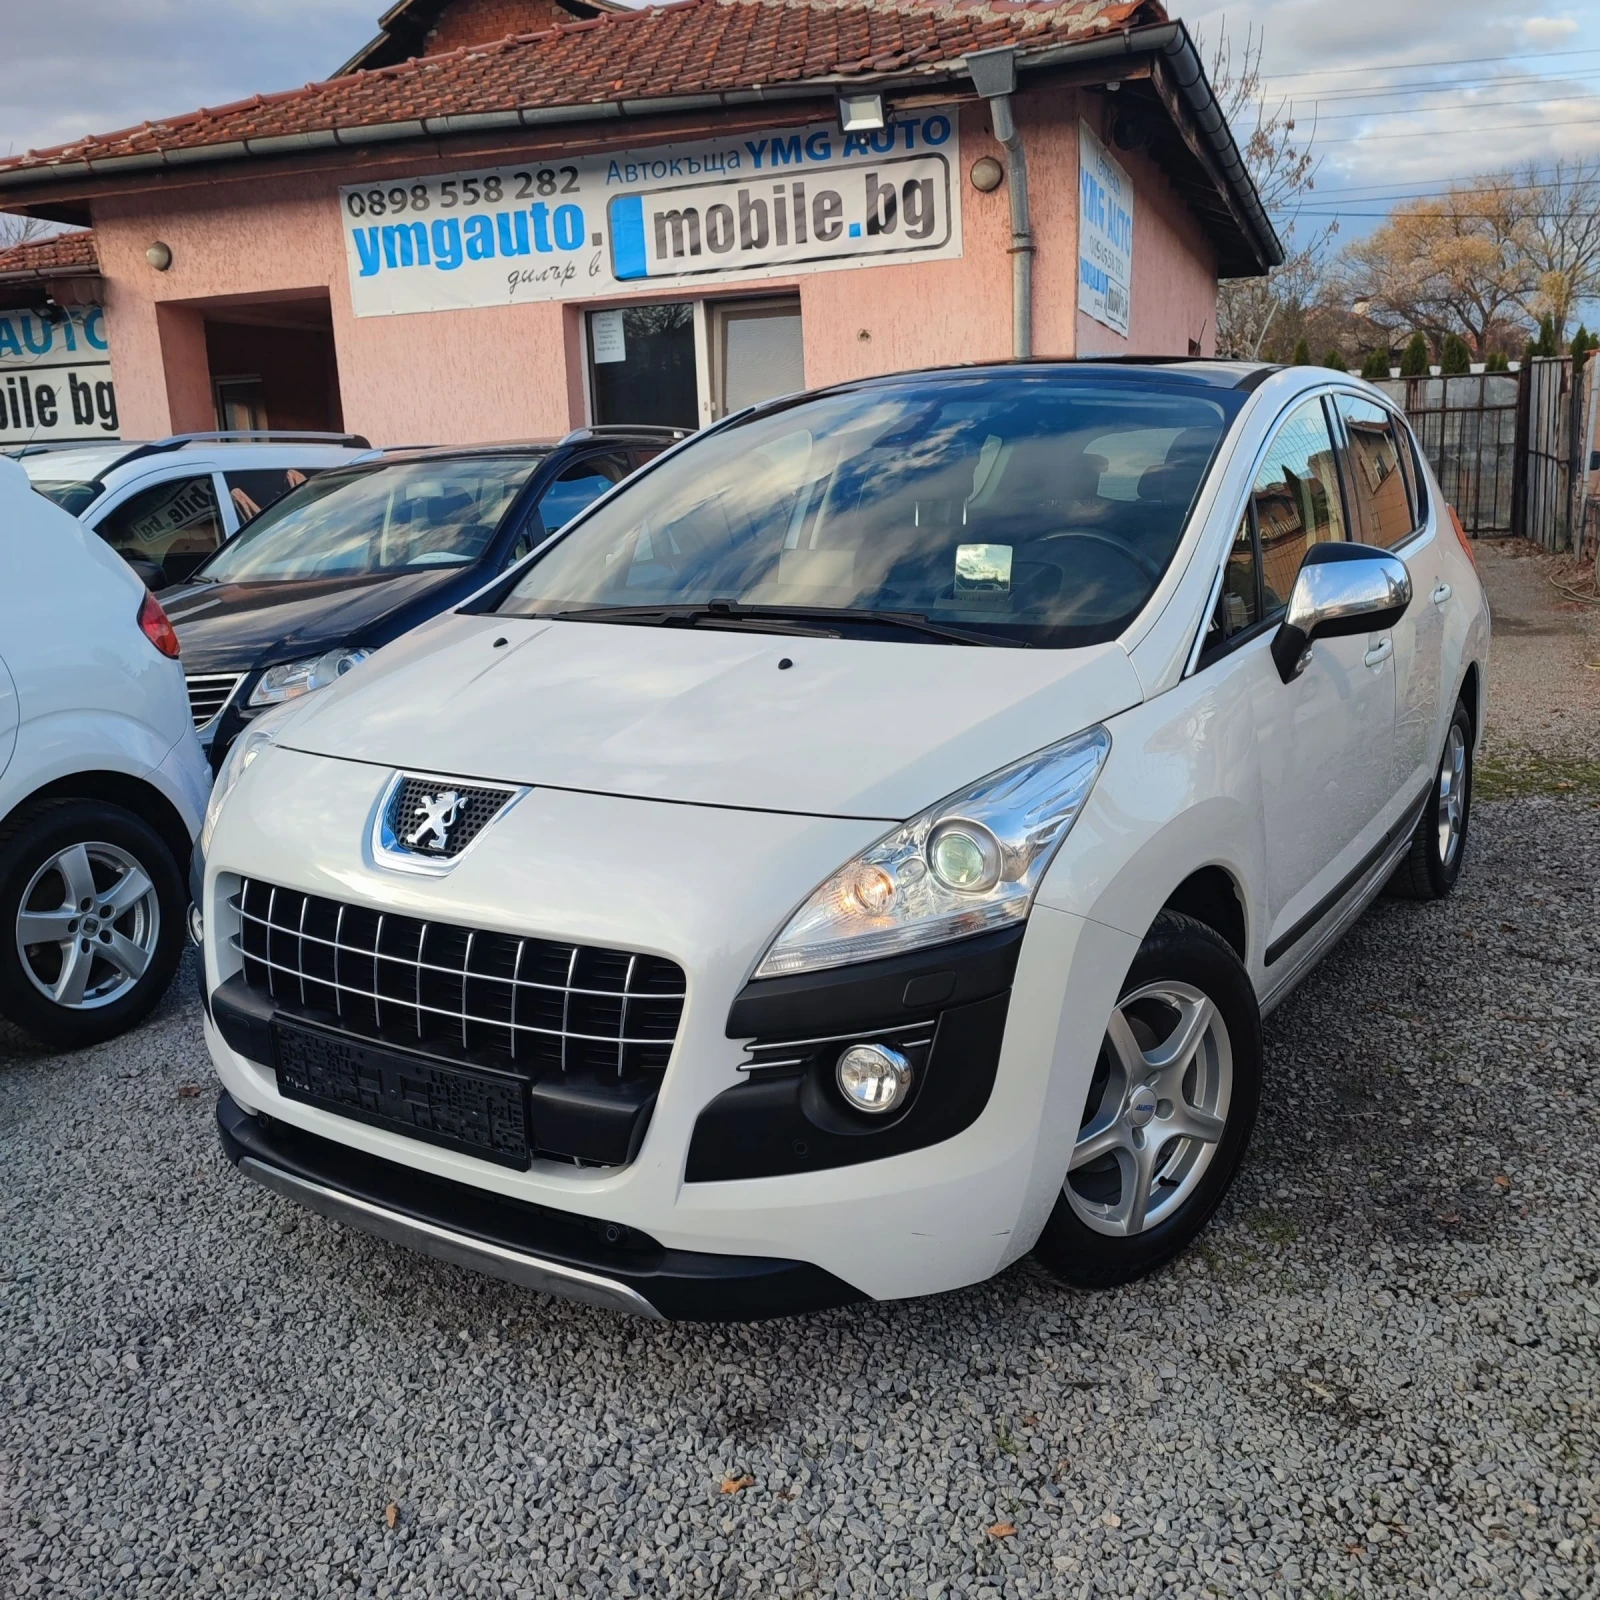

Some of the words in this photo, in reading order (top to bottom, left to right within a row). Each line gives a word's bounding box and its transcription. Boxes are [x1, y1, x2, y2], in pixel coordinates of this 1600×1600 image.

[606, 150, 741, 185] Автокъща
[744, 131, 832, 168] YMG
[843, 115, 951, 158] AUTO
[347, 184, 431, 218] 0898
[440, 176, 504, 209] 558
[513, 165, 581, 200] 282
[653, 171, 936, 260] mobile.bg
[1107, 196, 1131, 258] AUTO
[507, 260, 578, 295] дилър
